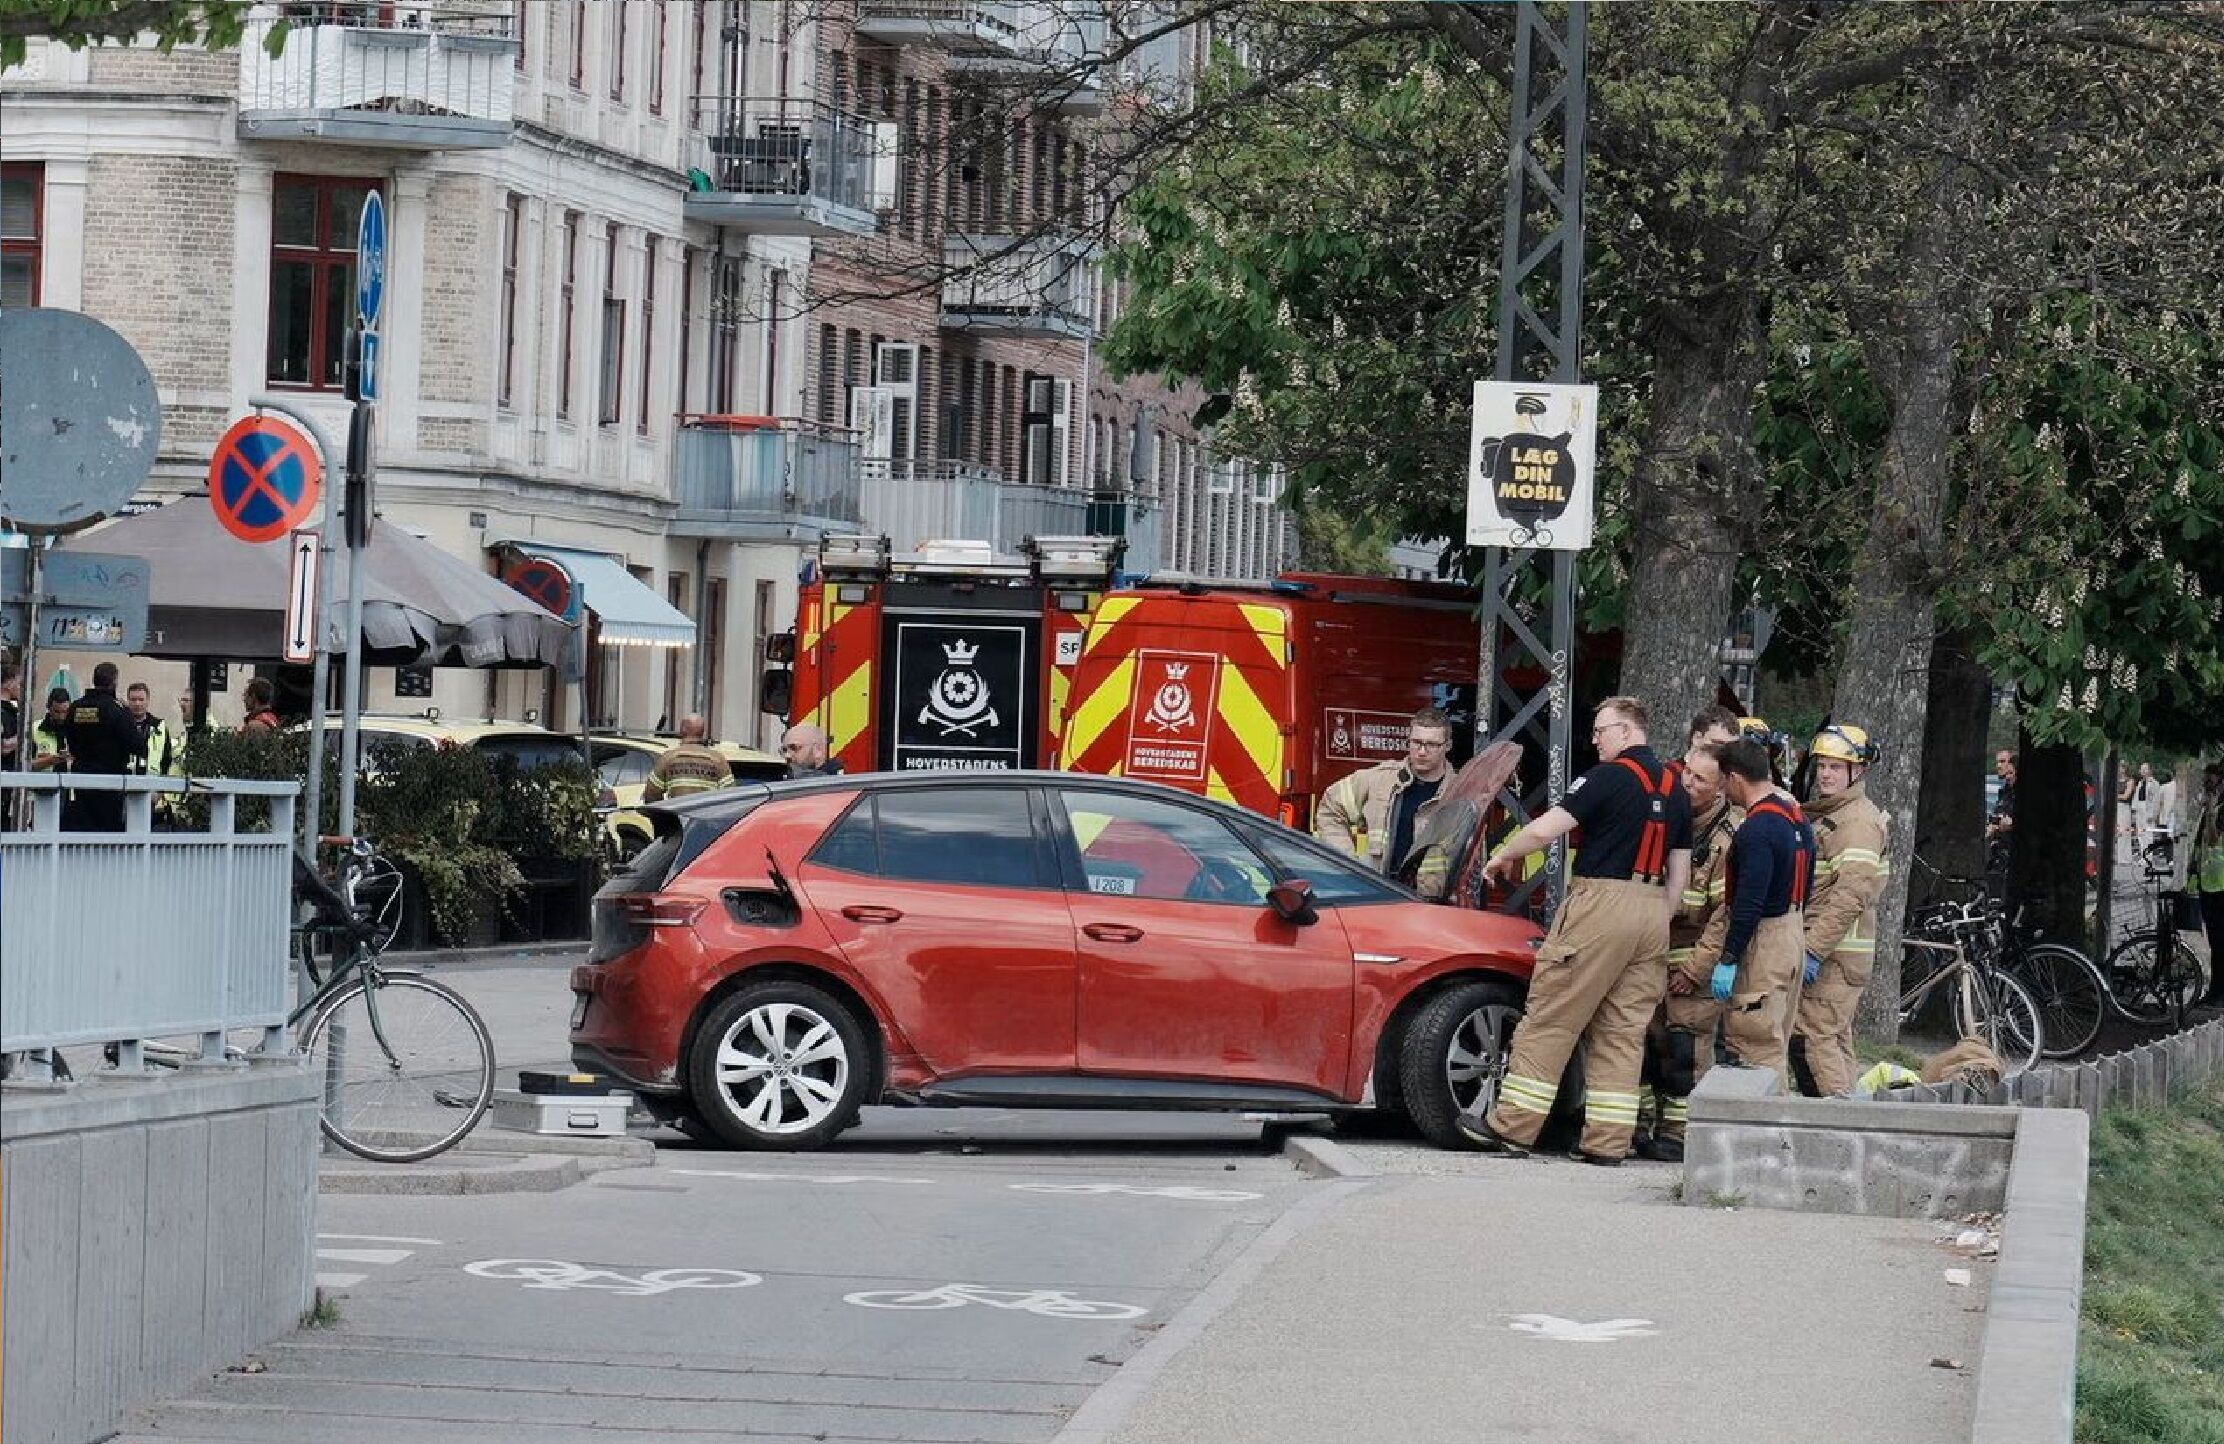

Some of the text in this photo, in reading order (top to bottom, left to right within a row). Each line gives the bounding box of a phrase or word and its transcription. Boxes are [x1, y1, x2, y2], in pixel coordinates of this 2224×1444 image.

[1510, 447, 1559, 465] LÆG
[1514, 465, 1552, 484] DIN
[1498, 482, 1566, 502] MOBIL
